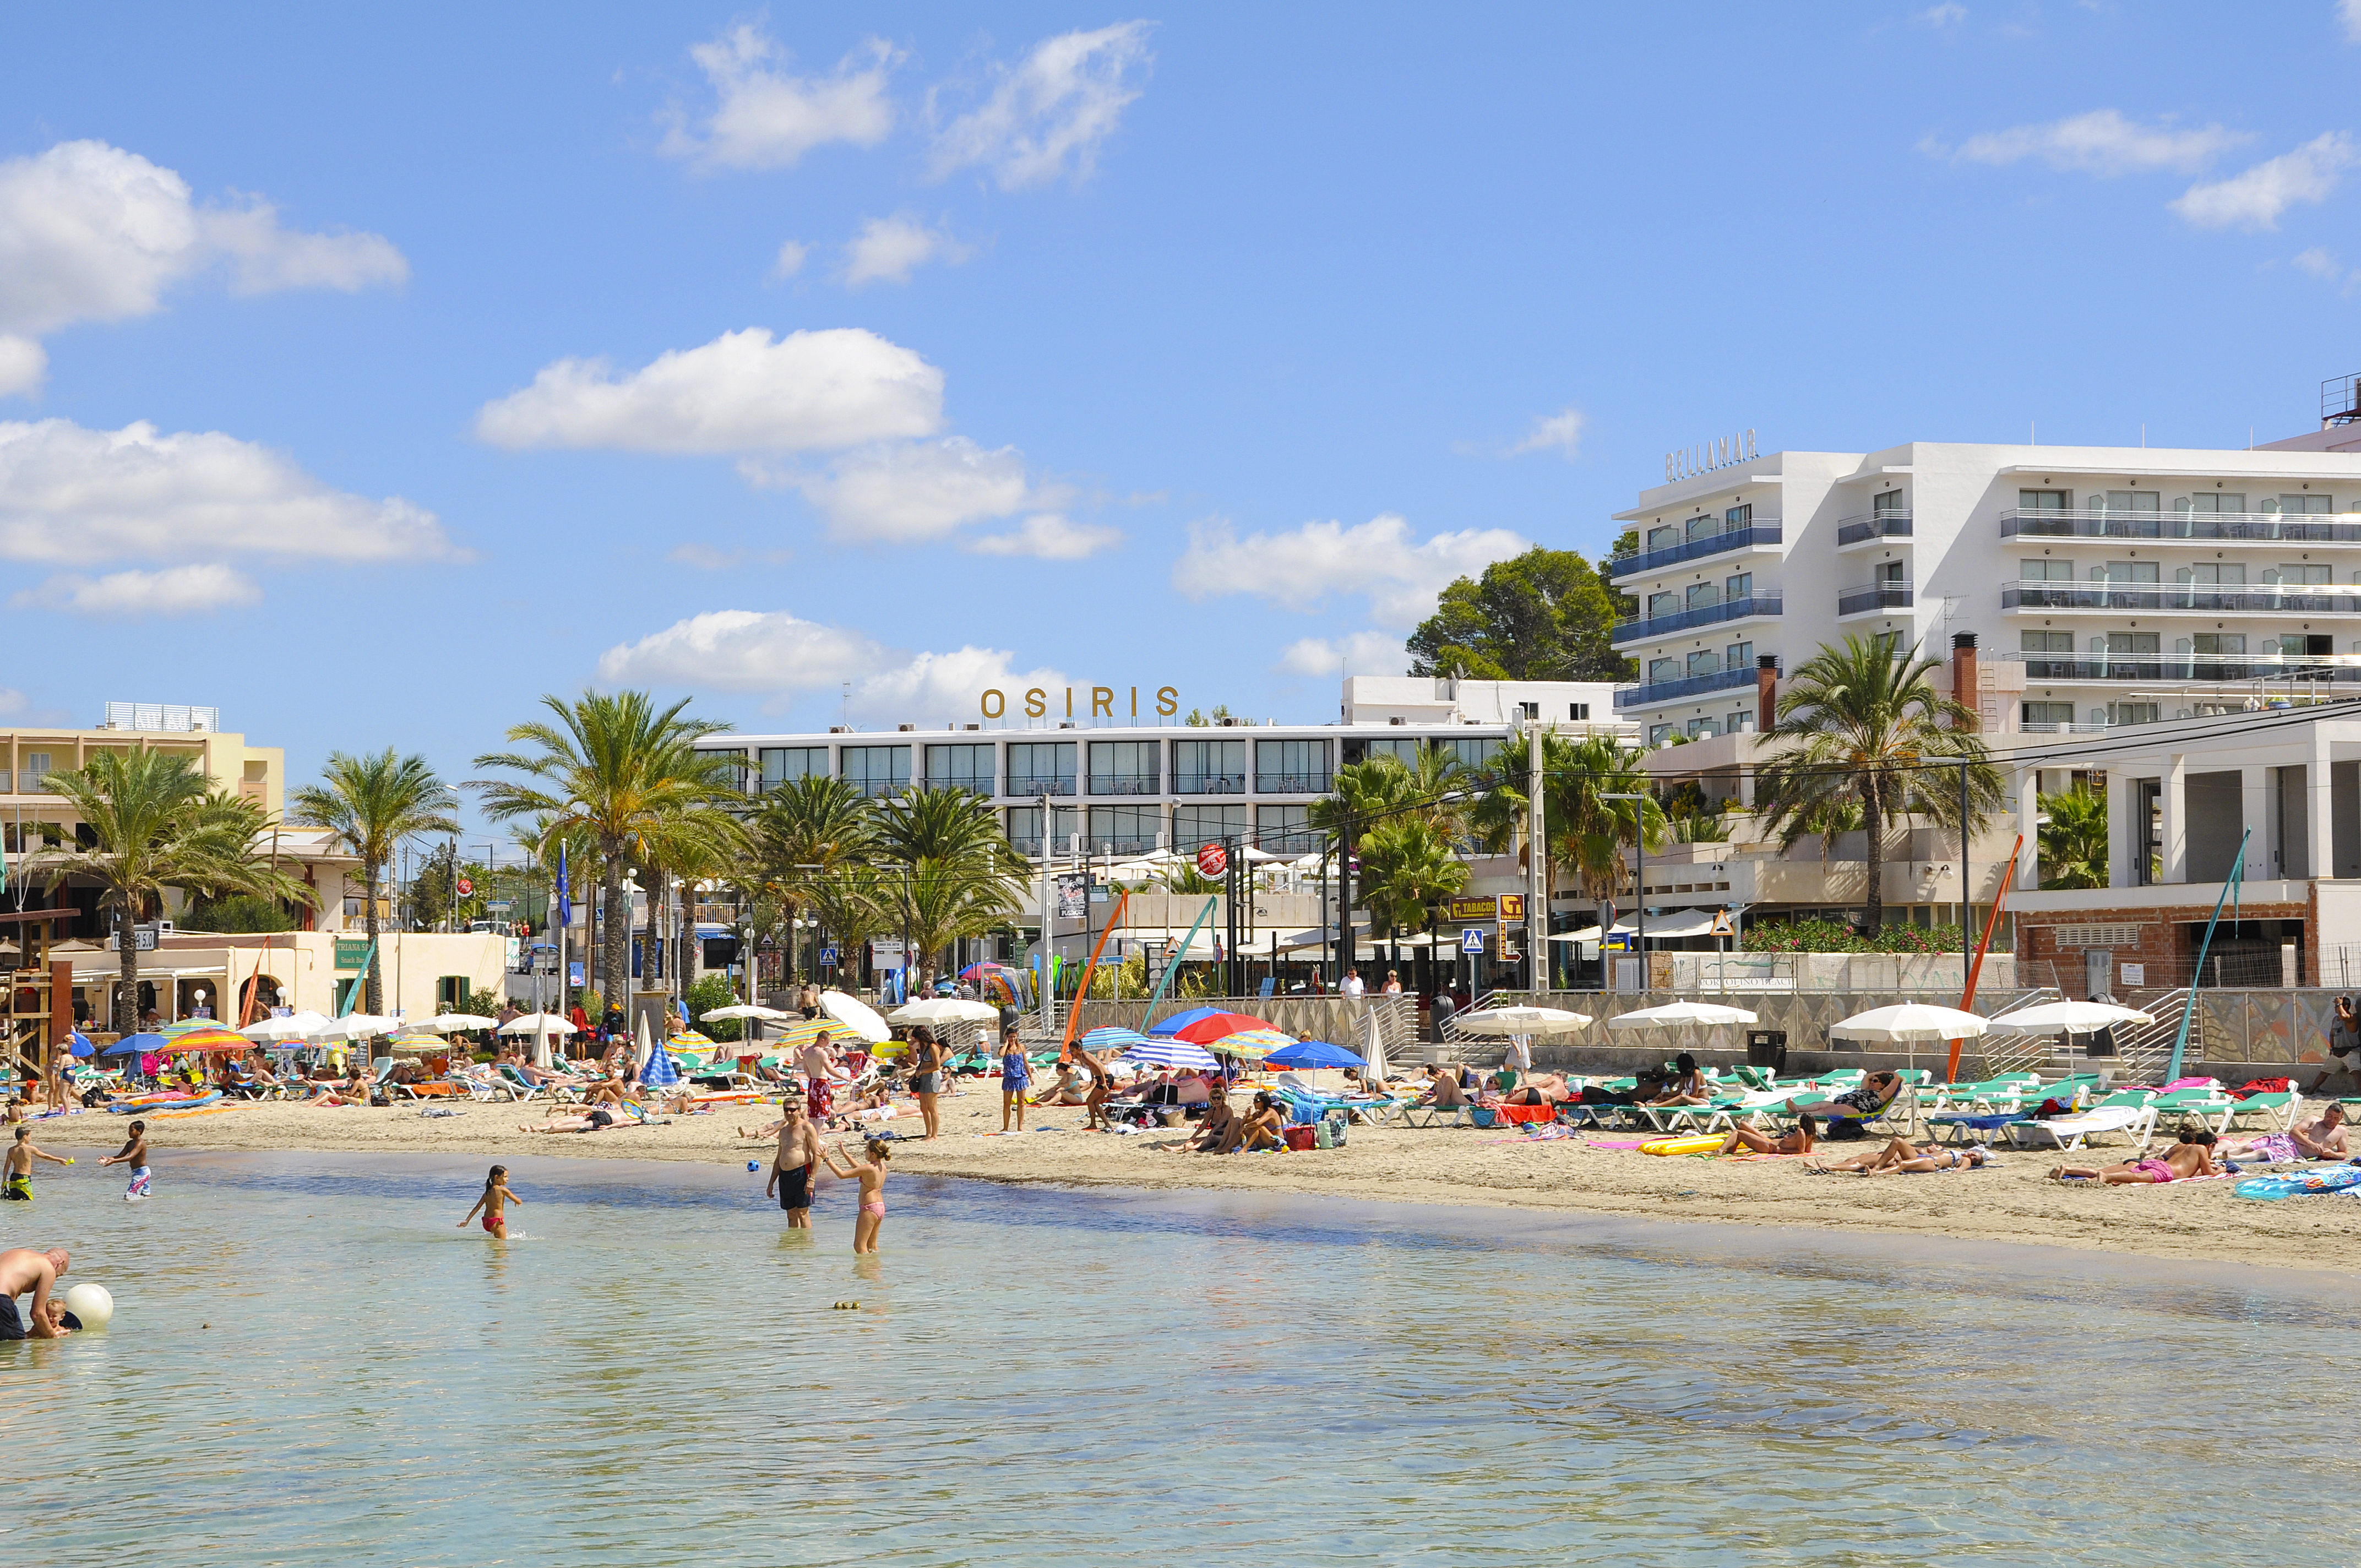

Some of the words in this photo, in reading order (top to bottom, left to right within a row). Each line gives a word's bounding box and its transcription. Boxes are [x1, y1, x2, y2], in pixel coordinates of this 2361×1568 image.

[1665, 428, 1755, 481] BELLAMAR
[981, 686, 1178, 718] OSIRIS
[1214, 871, 1226, 880] GLASS
[1462, 901, 1496, 913] TABACOS
[142, 933, 153, 948] 5.0
[336, 943, 361, 951] TRIANA
